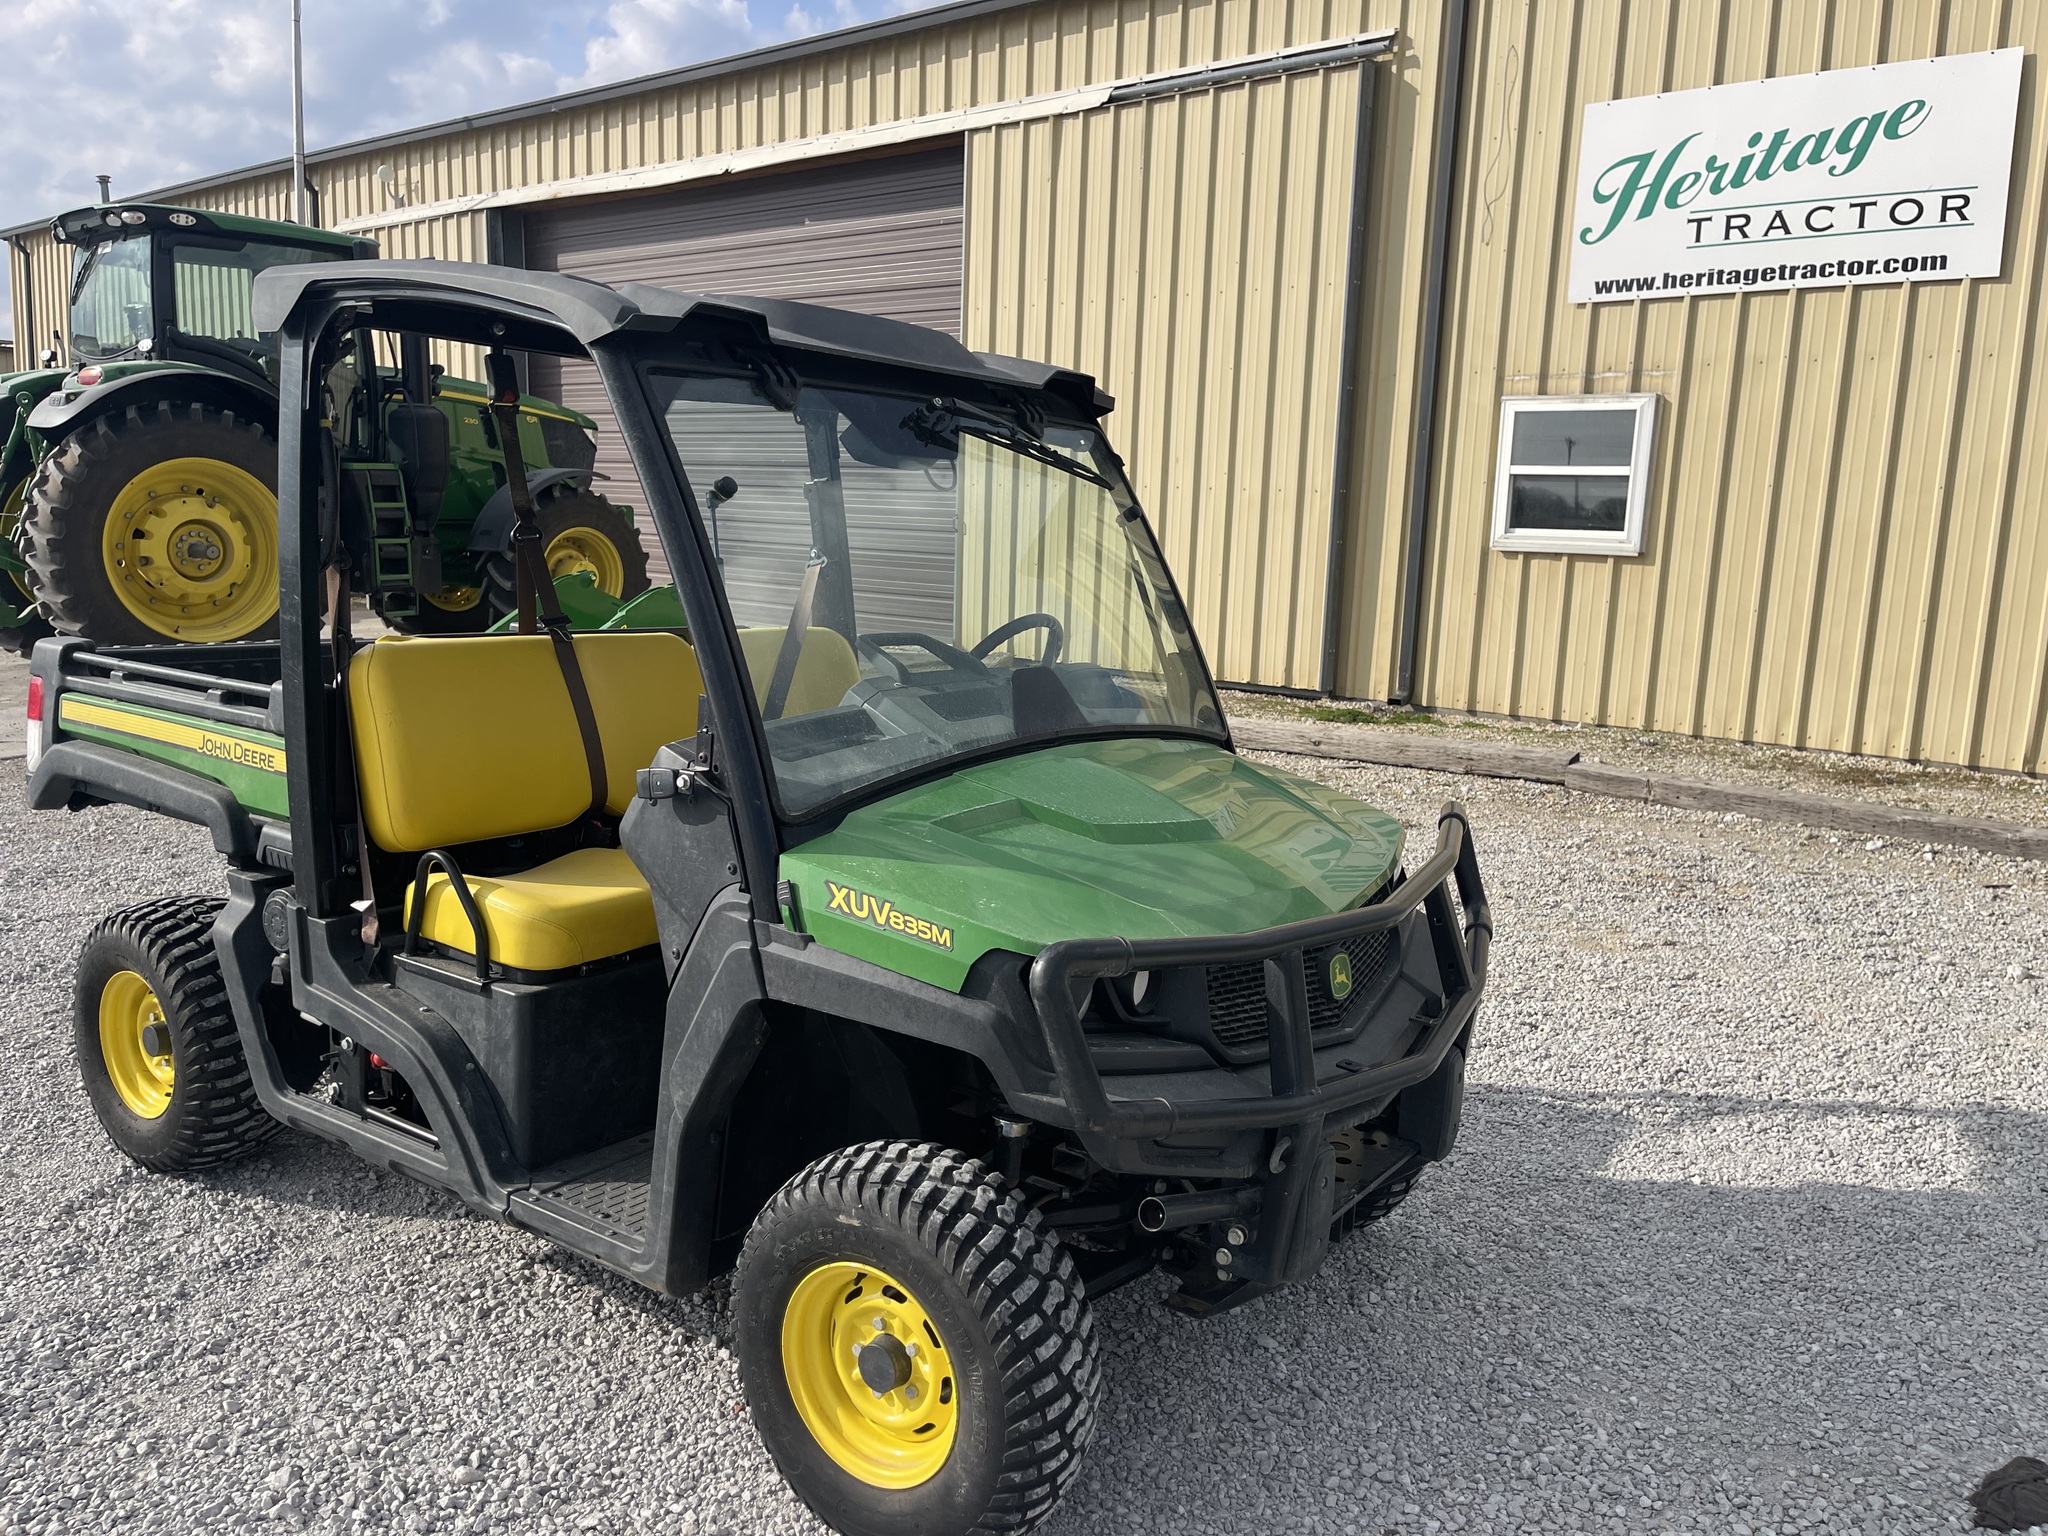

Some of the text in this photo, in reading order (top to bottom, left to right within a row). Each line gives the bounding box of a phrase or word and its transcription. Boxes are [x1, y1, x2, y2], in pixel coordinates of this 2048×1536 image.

[1579, 98, 1934, 246] Heritage
[1686, 193, 1971, 244] TRACTOR
[1593, 253, 1949, 295] www.heritagetractor.com
[464, 417, 479, 425] 230
[198, 734, 275, 769] JOHN DEERE
[828, 881, 952, 948] XUV835M
